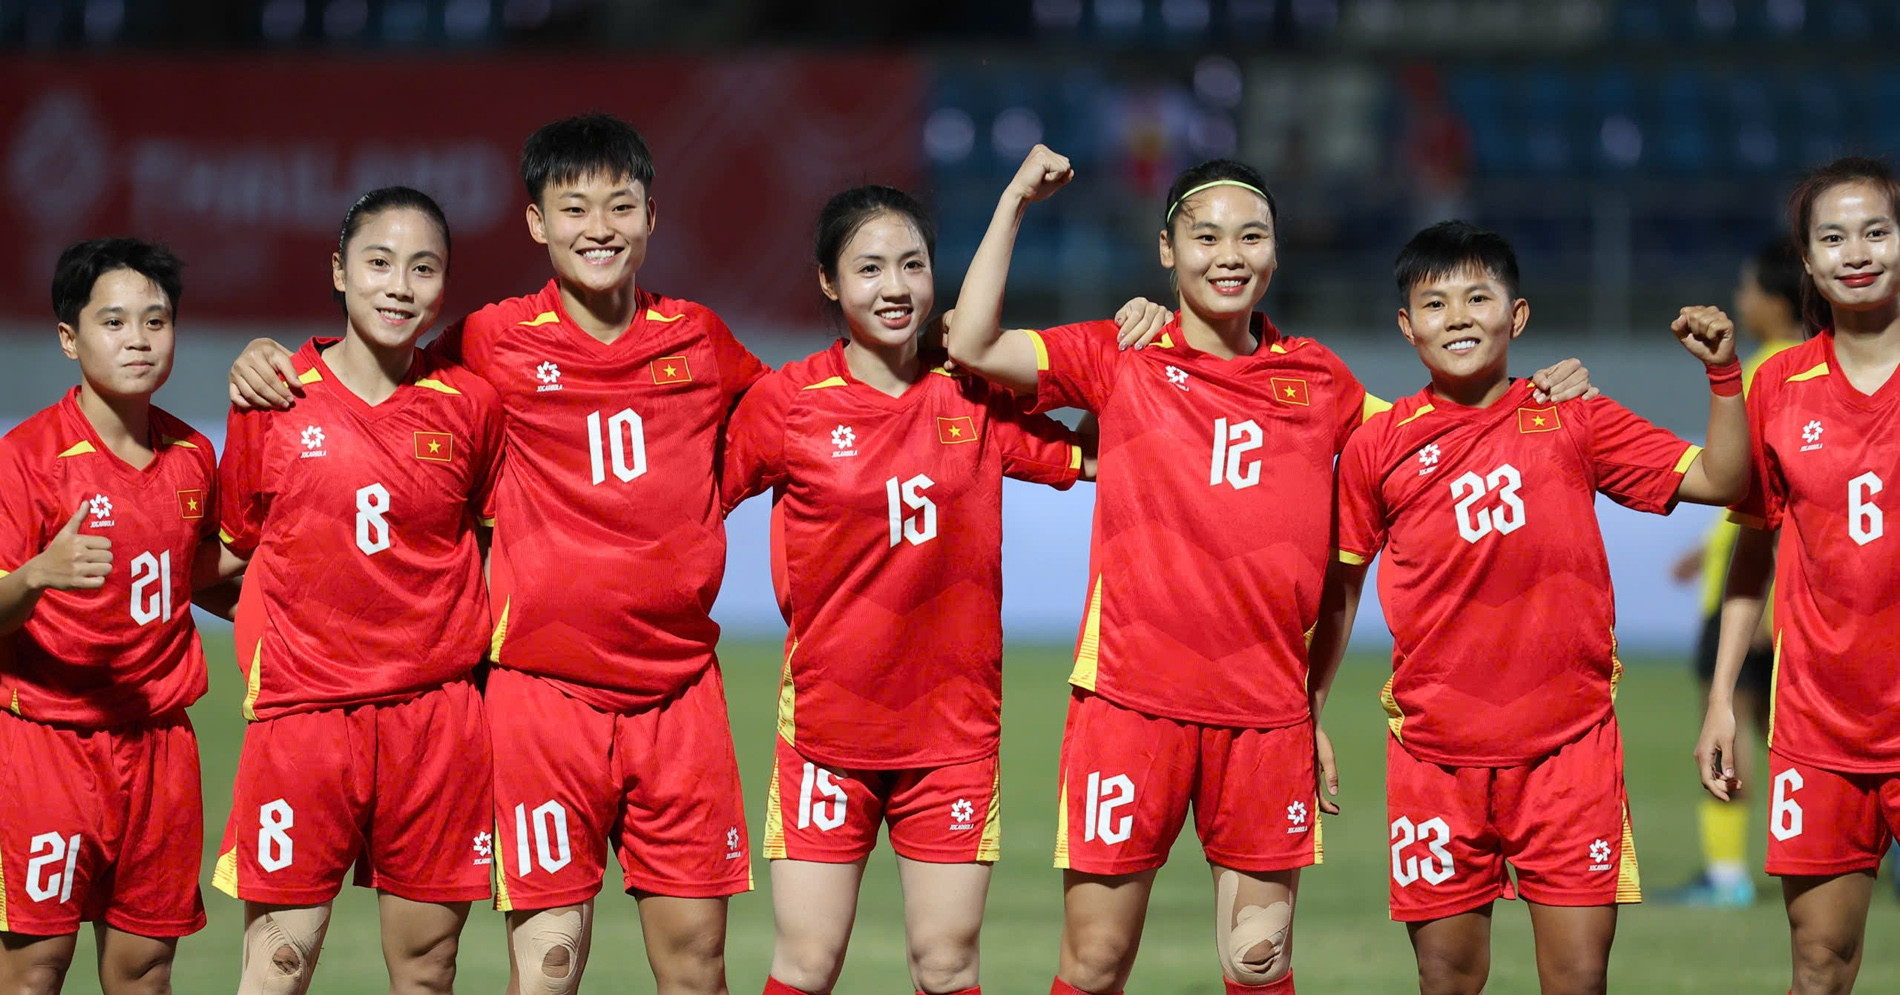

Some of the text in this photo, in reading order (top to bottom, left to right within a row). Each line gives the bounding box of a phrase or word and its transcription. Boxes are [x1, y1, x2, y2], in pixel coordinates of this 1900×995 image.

[586, 407, 648, 486] 10
[1209, 417, 1264, 491] 12
[355, 482, 391, 556] 8
[885, 473, 937, 548] 15
[1450, 463, 1526, 544] 23
[1847, 470, 1884, 546] 6
[130, 549, 171, 626] 21
[797, 761, 848, 832] 15
[1084, 771, 1135, 846] 12
[1770, 767, 1804, 842] 6
[25, 831, 81, 904] 21
[257, 798, 294, 873] 8
[514, 799, 572, 878] 10
[1391, 815, 1456, 888] 23
